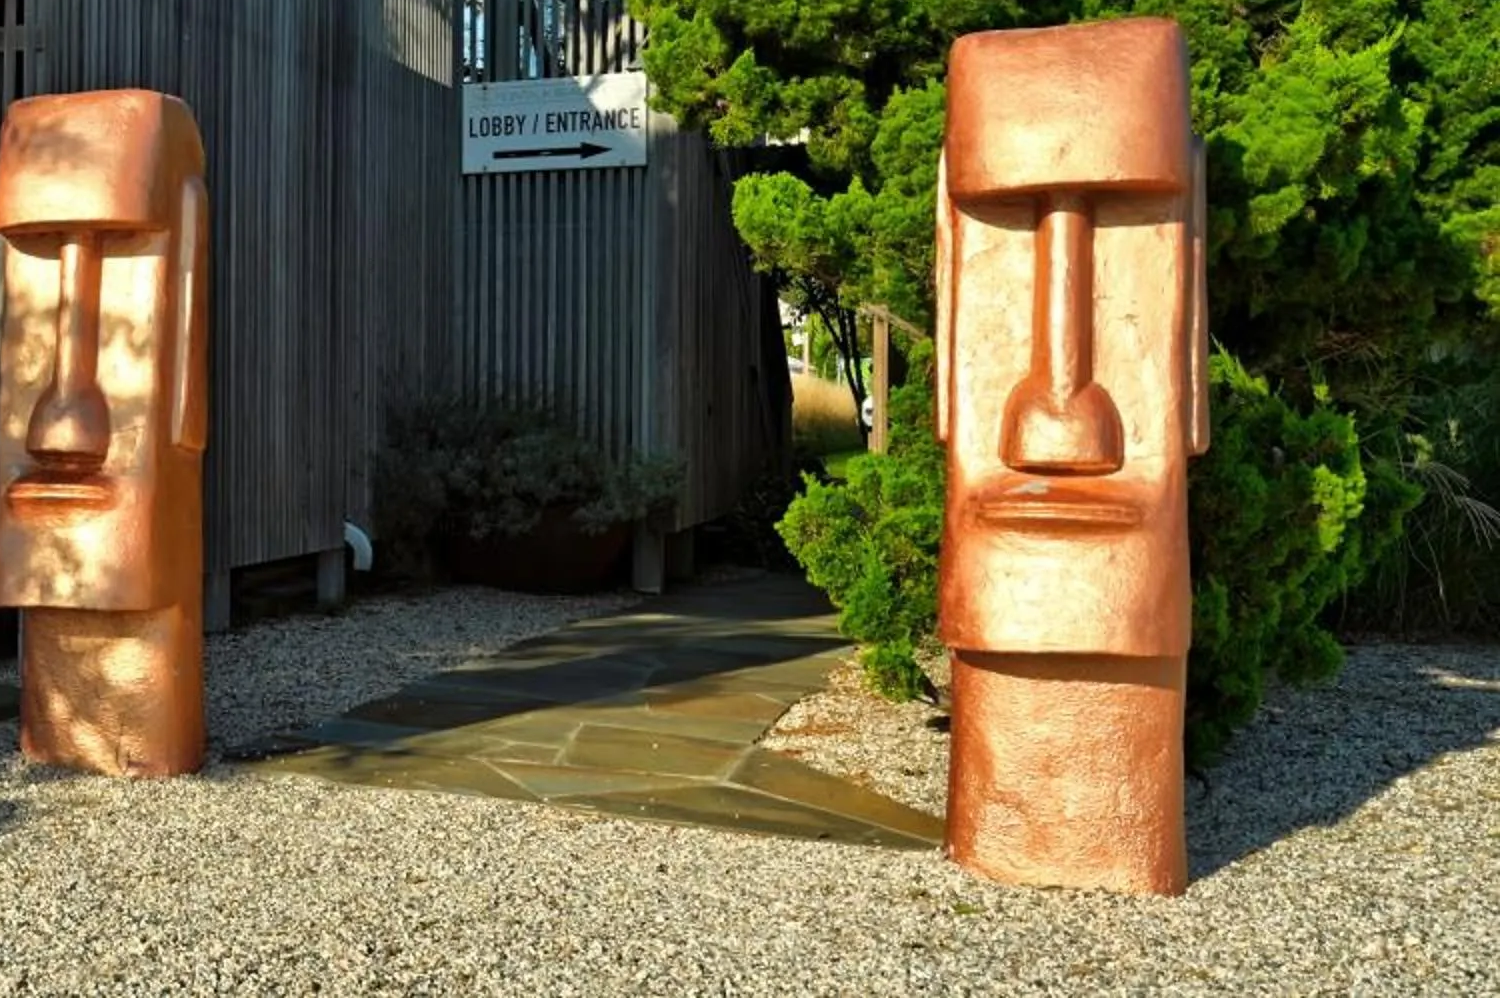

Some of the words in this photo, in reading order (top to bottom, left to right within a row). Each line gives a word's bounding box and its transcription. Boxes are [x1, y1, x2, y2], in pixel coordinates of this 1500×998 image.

[469, 114, 526, 138] LOBBY
[532, 113, 539, 134] /
[546, 107, 641, 133] ENTRANCE
